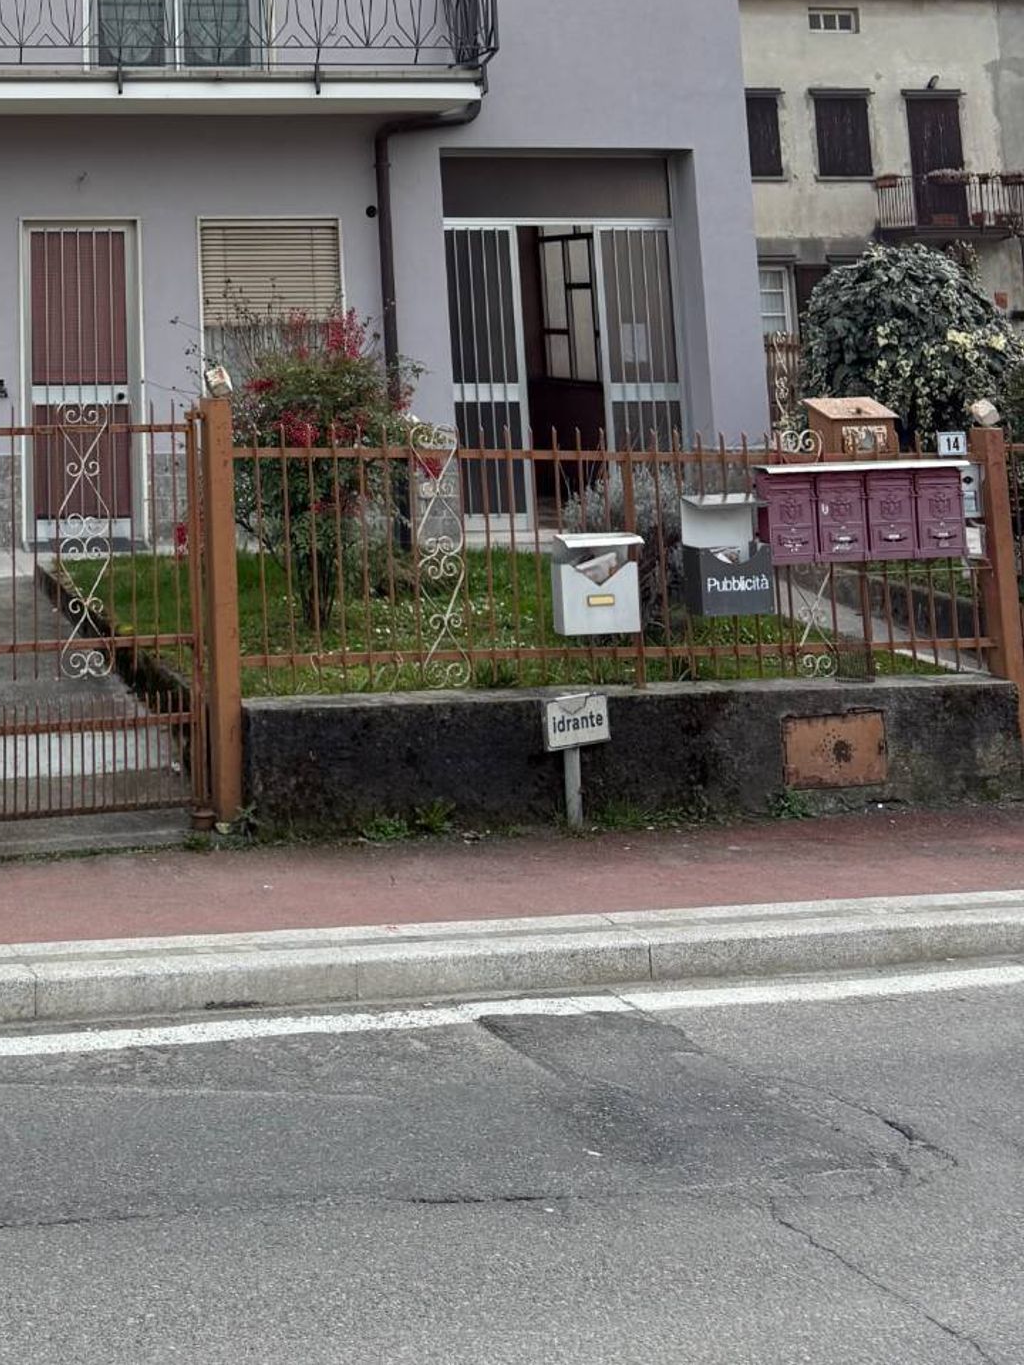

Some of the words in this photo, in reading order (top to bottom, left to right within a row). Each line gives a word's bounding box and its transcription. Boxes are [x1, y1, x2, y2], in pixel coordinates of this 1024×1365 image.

[946, 436, 960, 452] 14
[706, 573, 770, 593] Pubblicità
[552, 710, 604, 734] idrante
